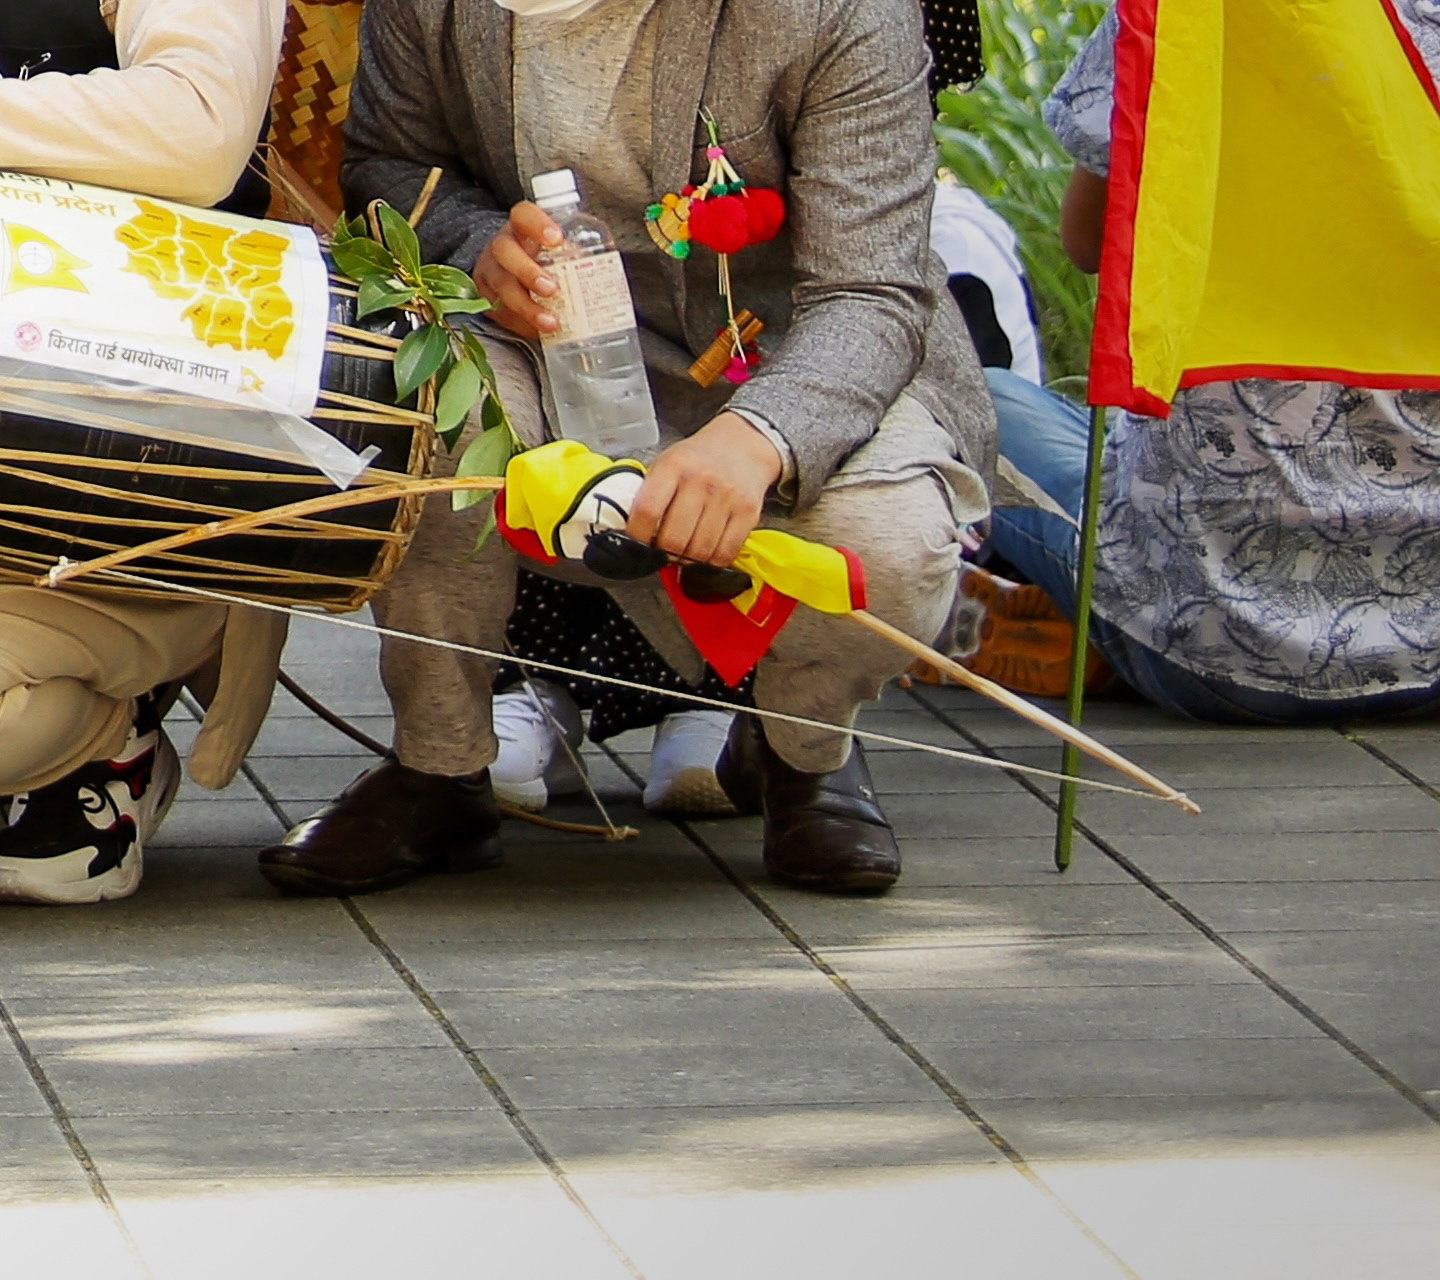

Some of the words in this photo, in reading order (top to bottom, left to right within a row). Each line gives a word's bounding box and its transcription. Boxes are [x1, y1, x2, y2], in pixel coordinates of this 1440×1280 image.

[50, 192, 118, 218] प्रदेश
[47, 328, 90, 355] किरात
[96, 341, 119, 361] राई
[188, 360, 229, 385] जापान
